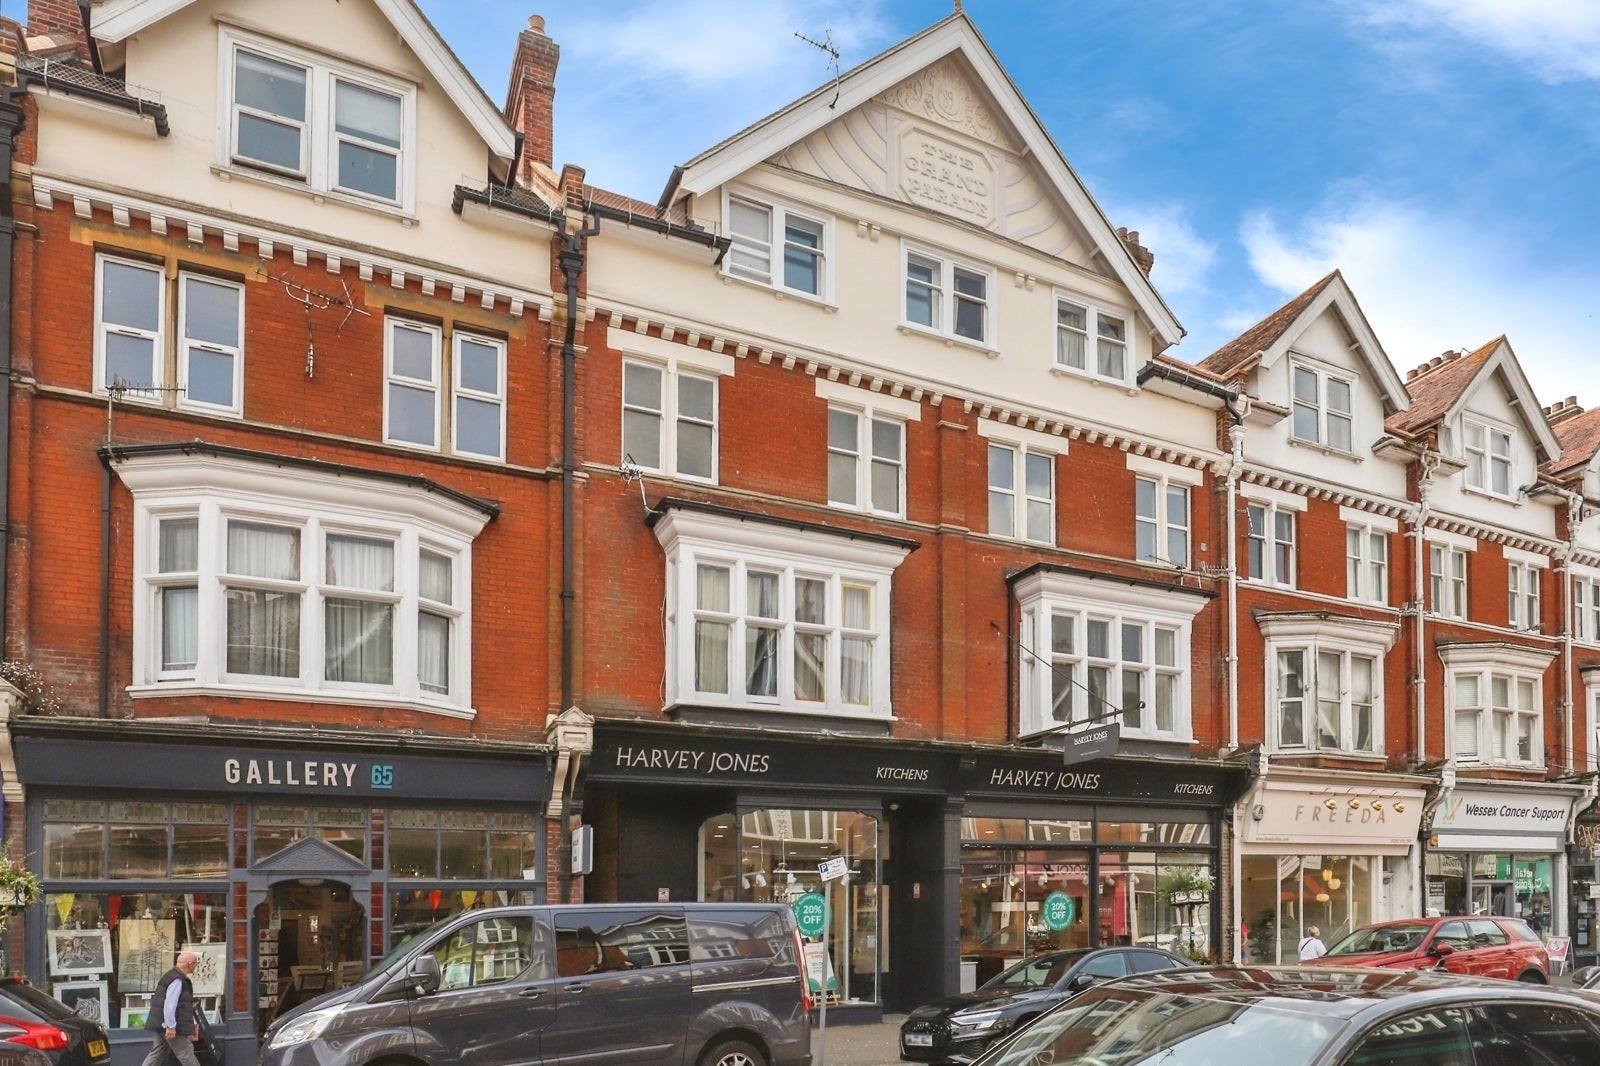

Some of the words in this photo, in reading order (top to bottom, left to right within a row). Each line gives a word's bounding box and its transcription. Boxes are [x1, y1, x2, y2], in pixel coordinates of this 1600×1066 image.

[921, 143, 974, 171] THE
[904, 156, 988, 197] GRAND
[616, 747, 705, 770] HARVEY
[707, 752, 769, 773] JONES
[224, 759, 357, 787] GALLERY
[371, 764, 393, 789] 65
[876, 766, 929, 780] KITCHENS
[990, 768, 1054, 787] HARVEY
[1054, 772, 1100, 790] JONES
[1174, 783, 1214, 795] KITCHENS
[1295, 805, 1386, 824] FREEDA
[1465, 803, 1498, 817] Wessex
[1499, 805, 1530, 818] Cancer
[1531, 806, 1565, 821] Support
[803, 905, 822, 914] 20%
[1051, 902, 1066, 911] 20%
[1051, 911, 1066, 920] OFF
[803, 915, 822, 925] OFF
